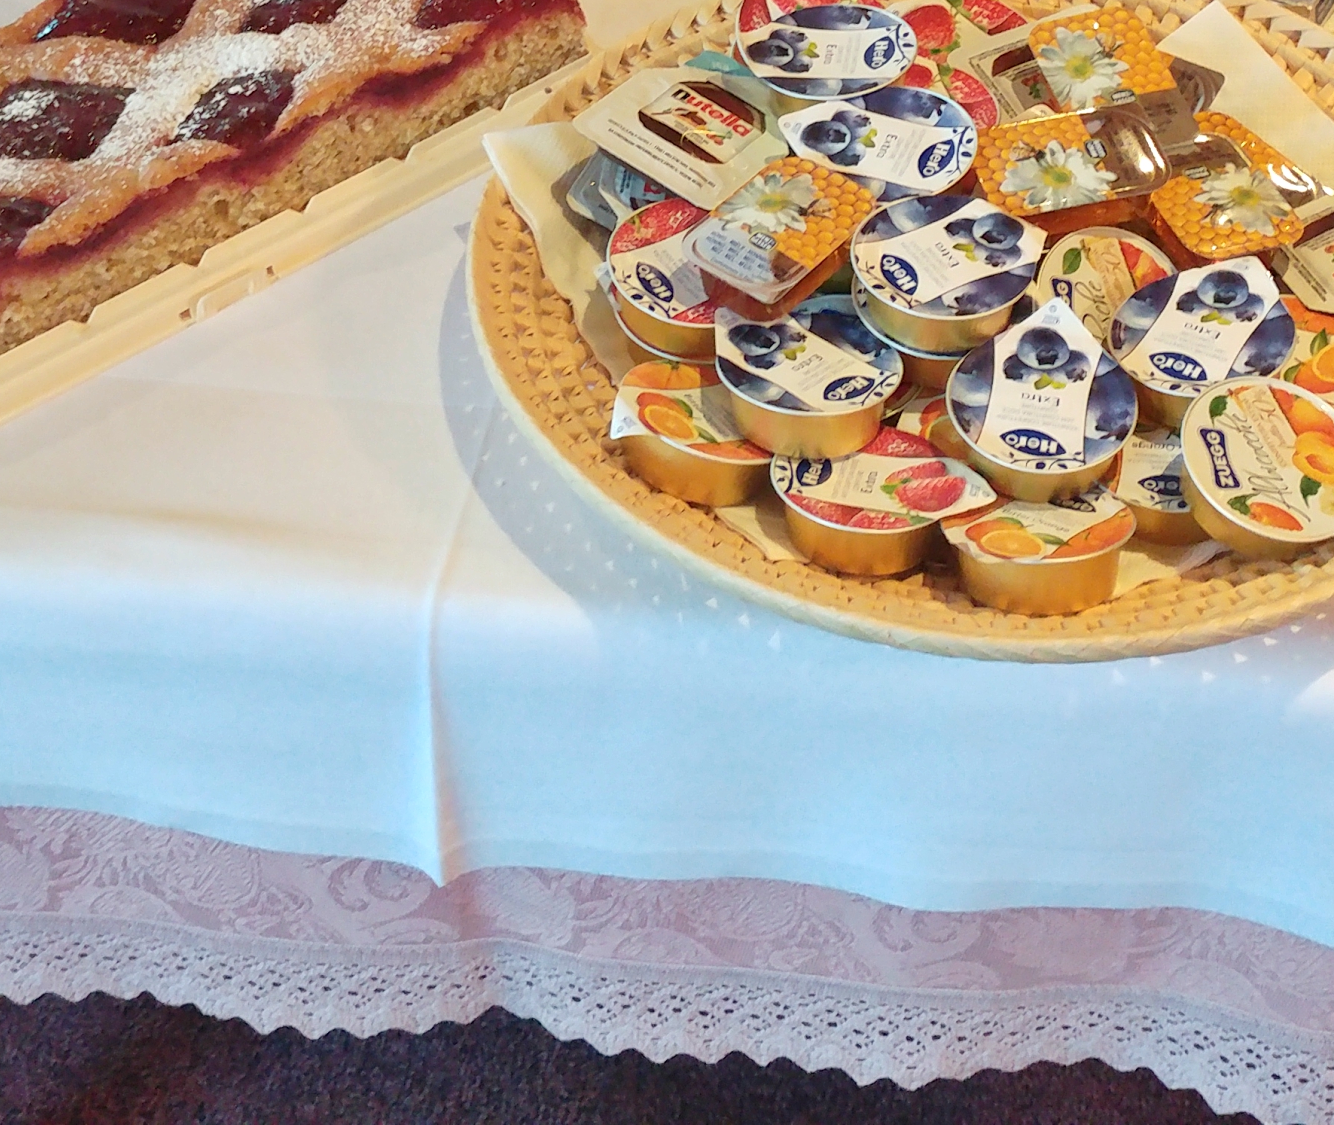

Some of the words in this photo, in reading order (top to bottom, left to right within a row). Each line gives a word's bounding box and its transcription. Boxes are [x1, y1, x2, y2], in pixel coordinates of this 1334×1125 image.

[824, 43, 837, 65] Extra
[870, 40, 888, 69] Hero
[671, 88, 753, 137] nutella
[875, 133, 898, 158] Extra
[923, 143, 948, 176] Hero
[935, 241, 960, 269] Extra
[637, 264, 673, 299] Hero
[882, 256, 917, 292] Hero
[1184, 322, 1221, 340] Extra
[1153, 354, 1203, 380] Hero
[827, 376, 870, 401] Hero
[1021, 392, 1061, 407] Extra
[1005, 433, 1059, 454] Hero
[801, 458, 827, 485] Her
[1206, 430, 1235, 488] ZUEGG
[860, 470, 878, 494] Extra
[1143, 478, 1181, 491] ero
